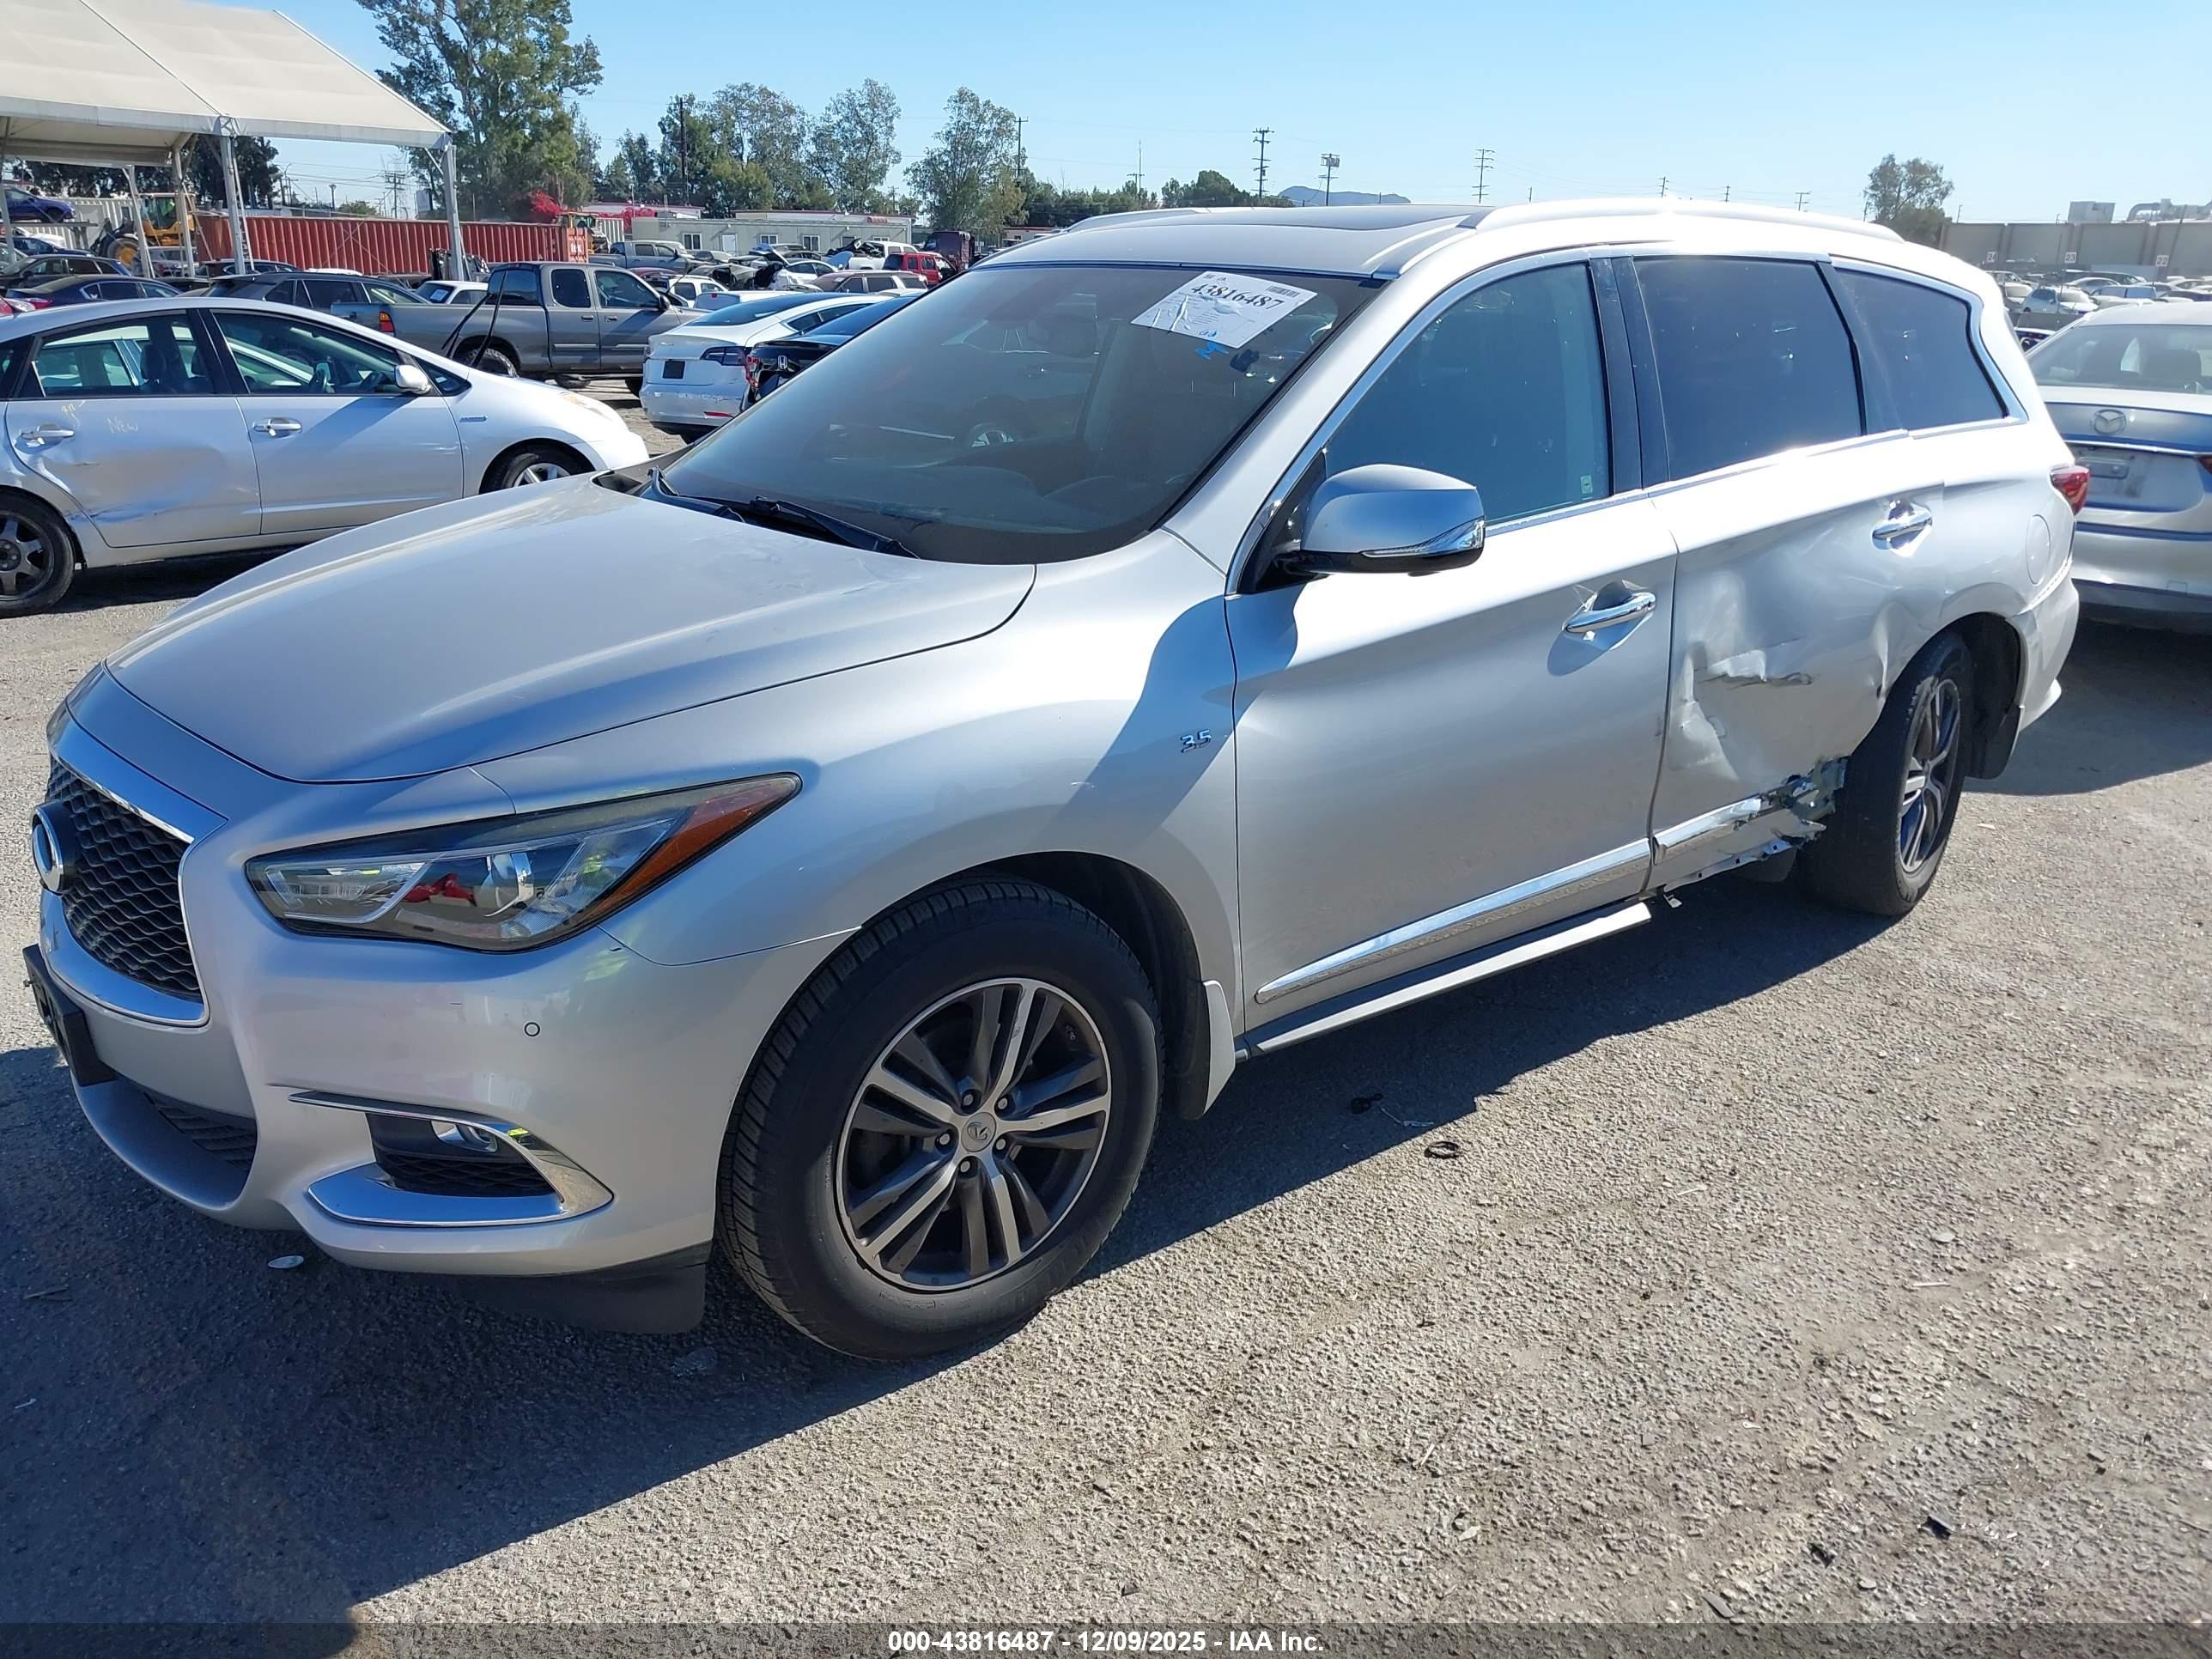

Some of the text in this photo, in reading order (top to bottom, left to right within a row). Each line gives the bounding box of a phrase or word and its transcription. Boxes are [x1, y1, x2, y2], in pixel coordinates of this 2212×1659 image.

[2065, 252, 2076, 263] 23
[2156, 257, 2168, 265] 22
[1191, 284, 1285, 310] 43816487
